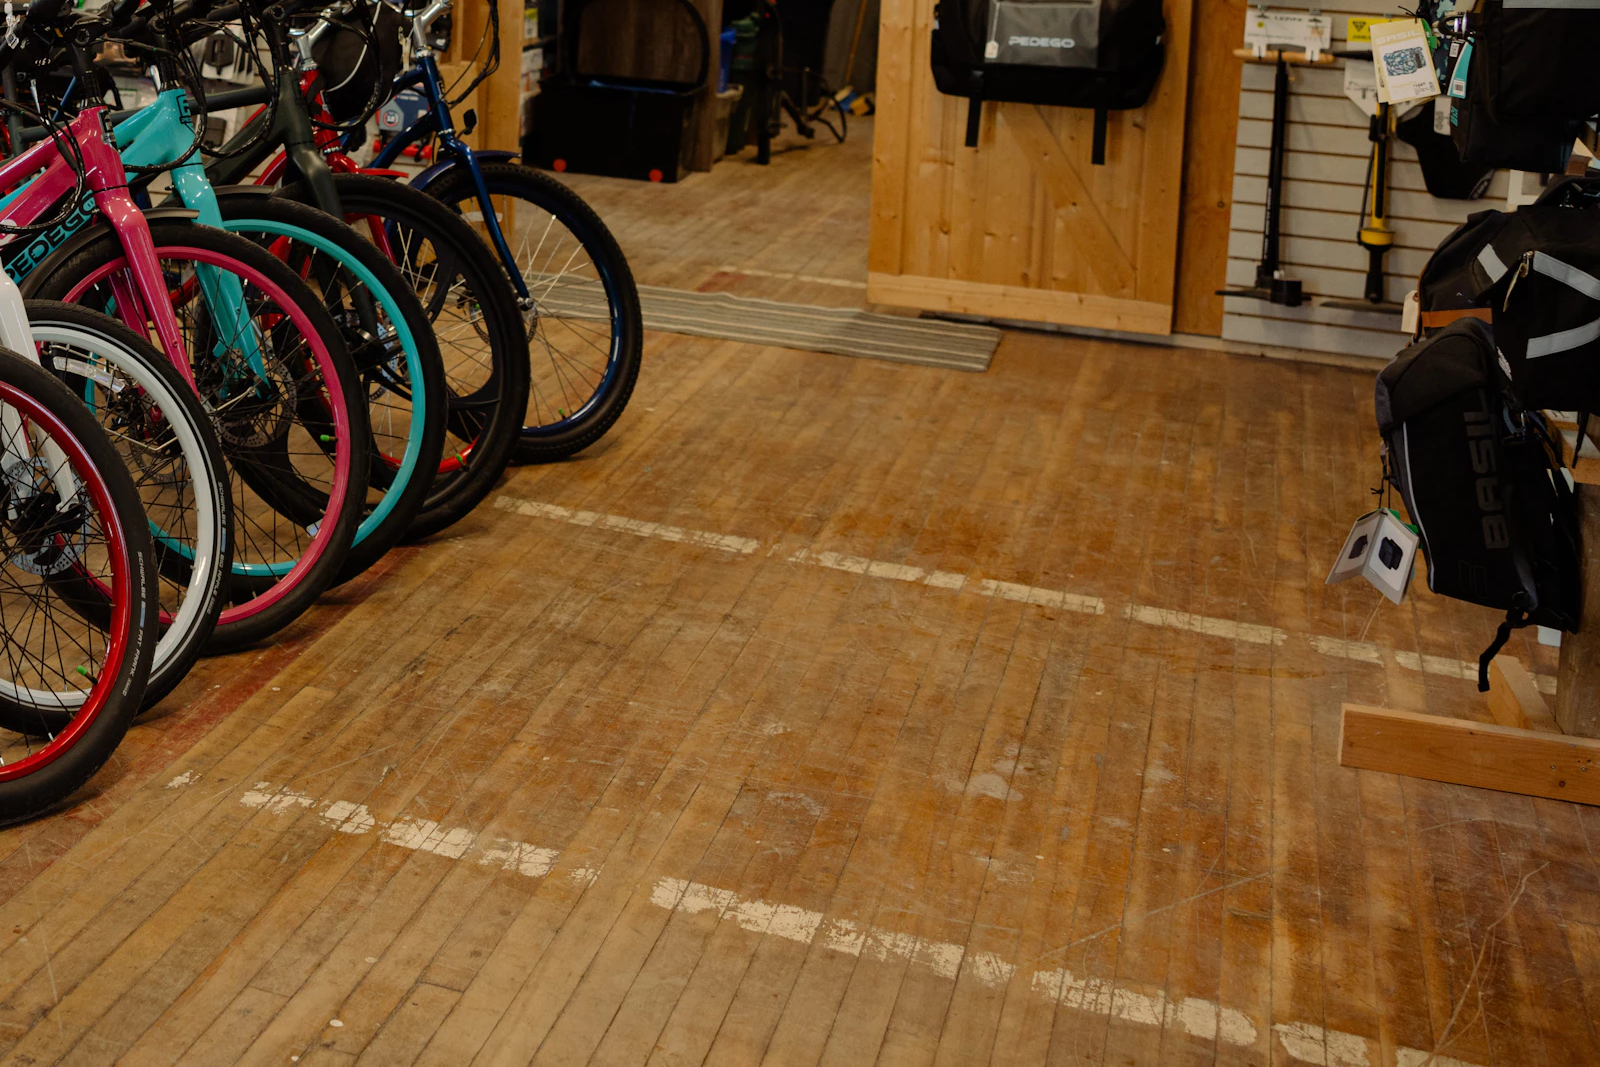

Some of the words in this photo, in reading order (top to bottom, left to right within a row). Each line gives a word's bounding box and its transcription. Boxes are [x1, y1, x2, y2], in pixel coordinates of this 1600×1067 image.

[1008, 35, 1075, 49] PEDEGO
[1376, 29, 1421, 45] BASIL
[1463, 388, 1509, 549] BASIL
